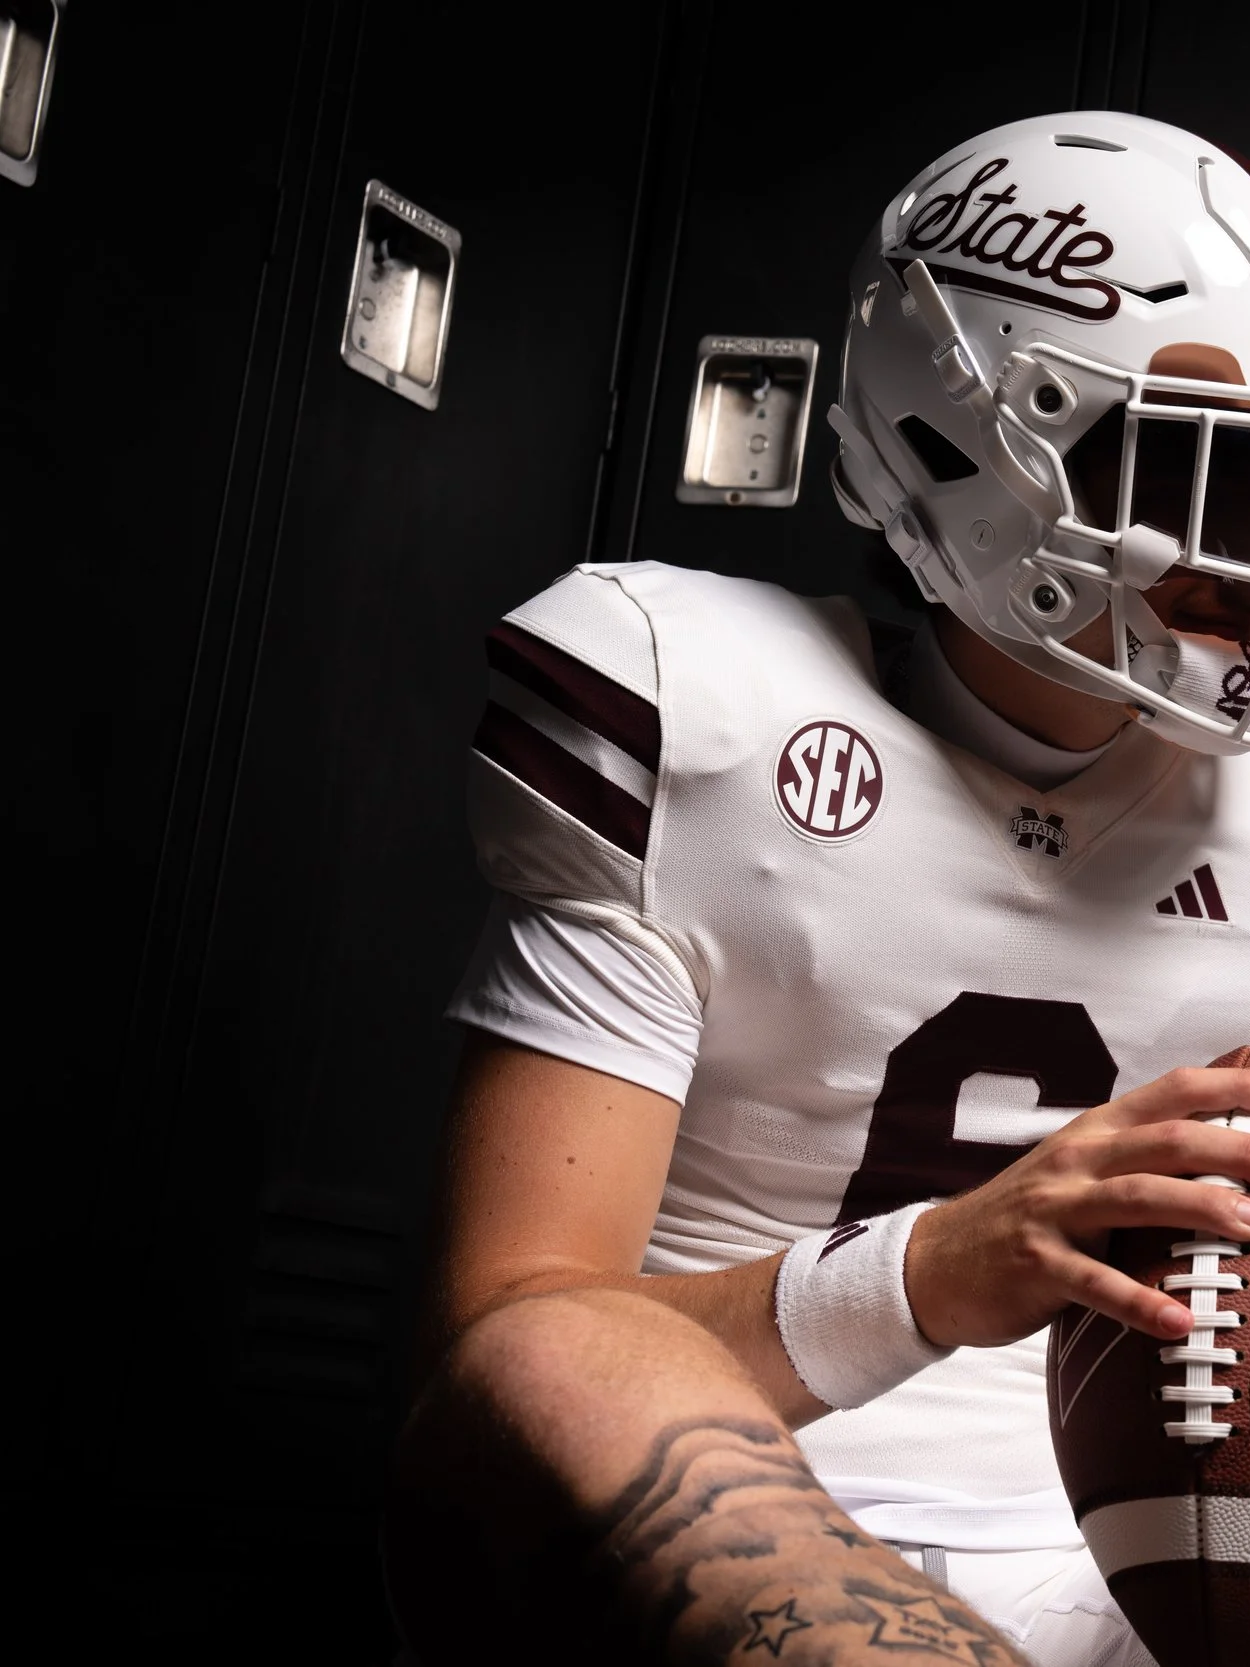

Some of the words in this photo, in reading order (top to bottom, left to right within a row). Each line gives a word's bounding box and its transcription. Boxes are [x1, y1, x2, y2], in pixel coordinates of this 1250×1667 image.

[888, 157, 1119, 300] State
[783, 727, 877, 831] SEC
[1022, 822, 1059, 841] STATE
